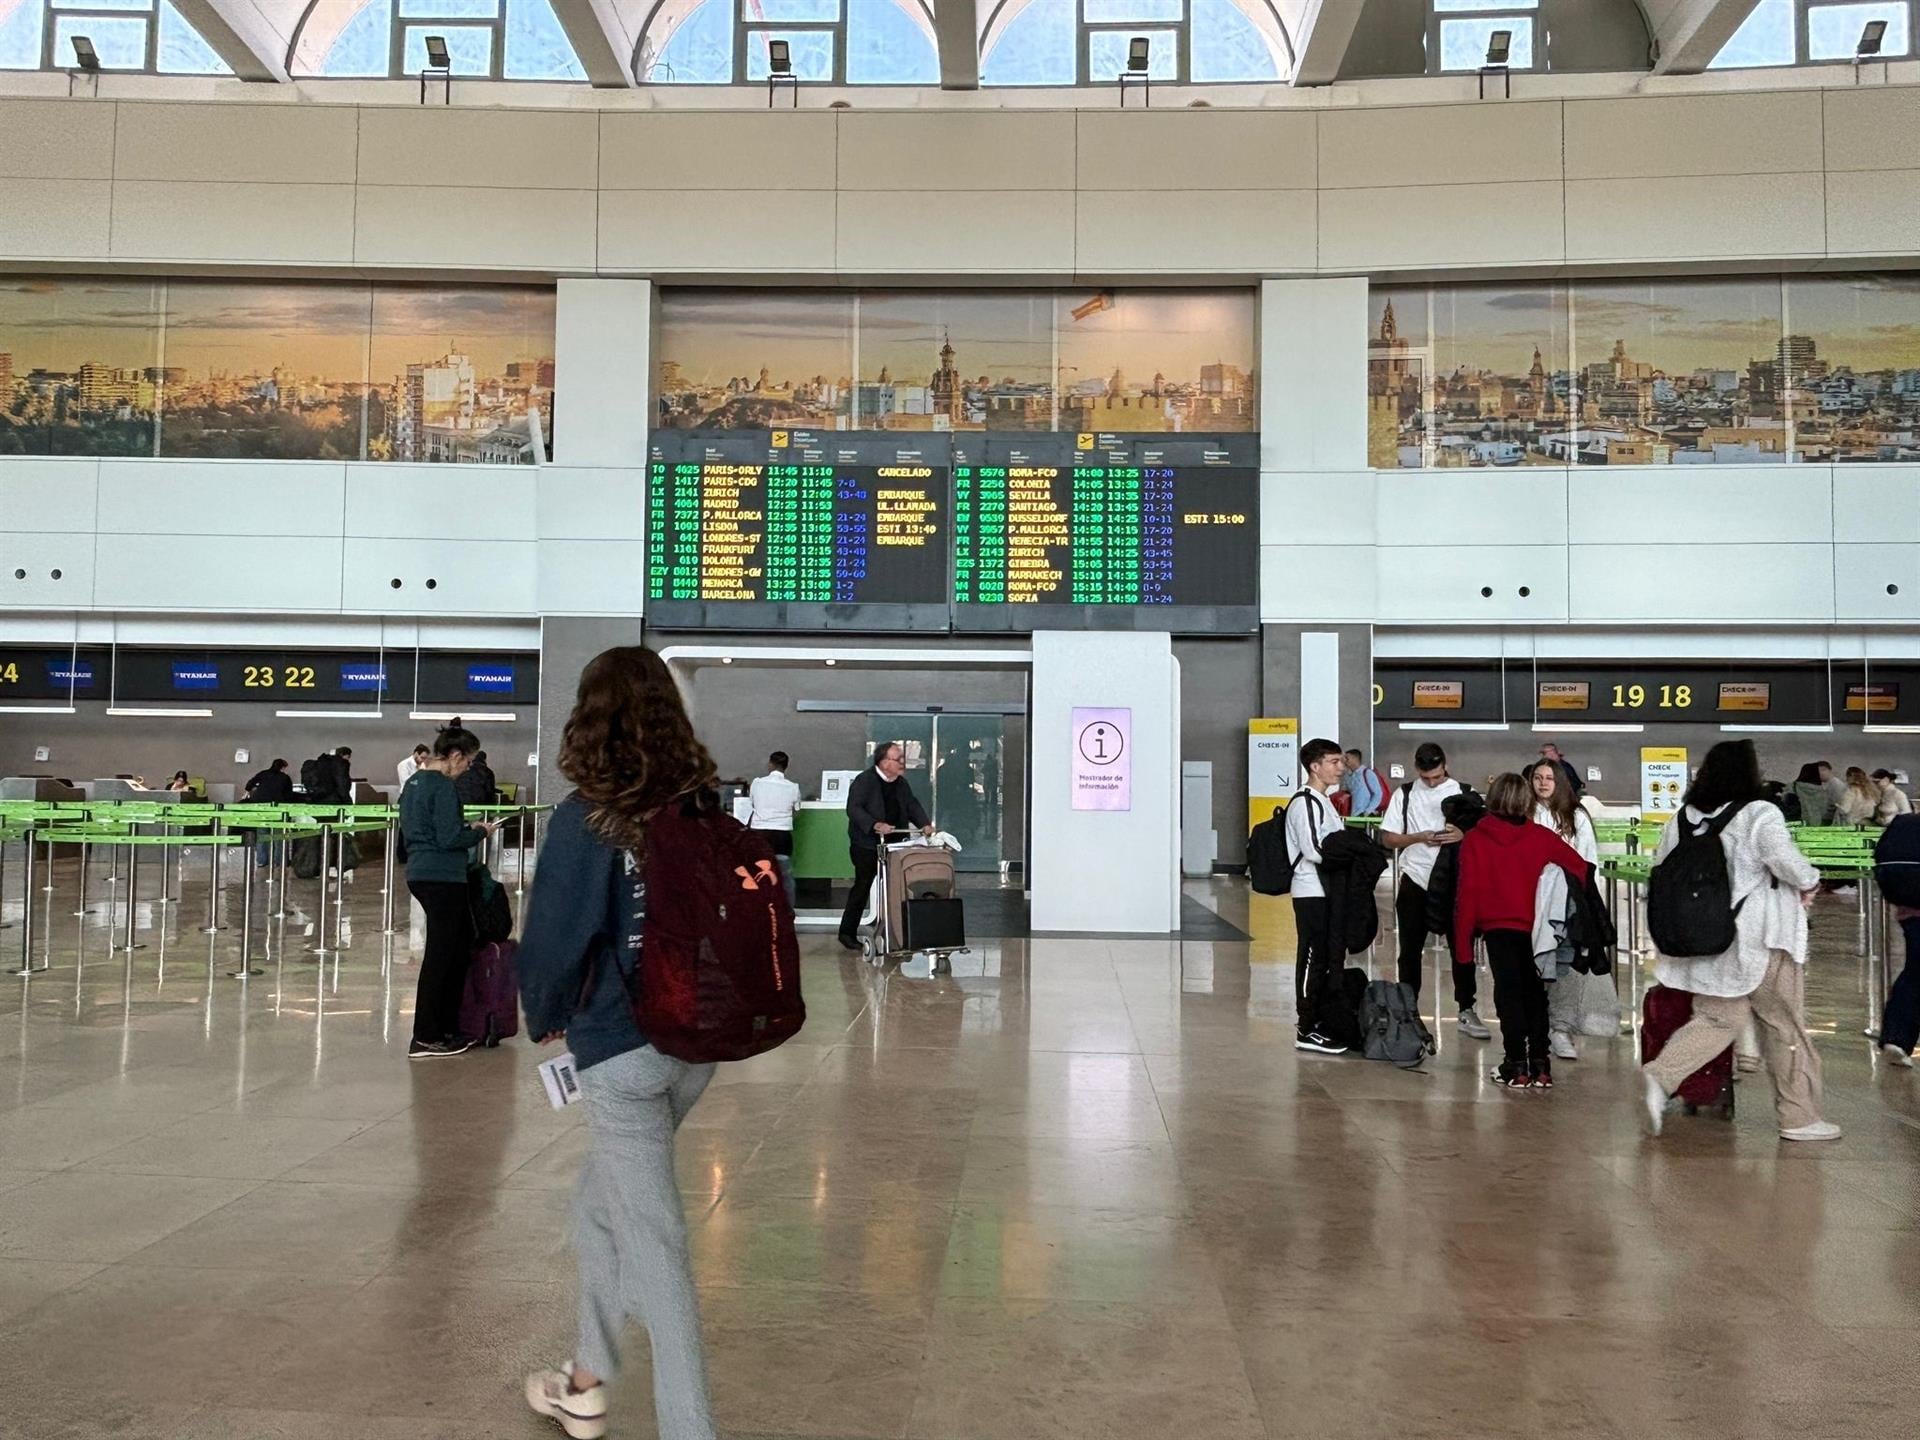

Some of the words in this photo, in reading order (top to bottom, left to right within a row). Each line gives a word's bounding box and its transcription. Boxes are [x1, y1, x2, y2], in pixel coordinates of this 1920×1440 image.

[704, 466, 762, 475] PARIS-ORLY
[768, 467, 797, 475] 11:45
[802, 467, 832, 475] 11:10
[878, 468, 931, 477] CANCELADO
[1009, 469, 1057, 477] ROMA-FCO
[1074, 469, 1103, 477] 14:00
[1108, 469, 1138, 477] 13:25
[675, 477, 699, 485] 1417
[704, 477, 756, 486] PARIS-CDG
[768, 478, 797, 486] 12:20
[802, 479, 832, 487] 11:45
[1073, 480, 1103, 489] 14:05
[1108, 481, 1138, 489] 13:30
[675, 489, 699, 497] 2141
[703, 489, 738, 497] ZURICH
[768, 490, 797, 498] 12:20
[878, 491, 925, 500] EMBARQUE
[1009, 491, 1051, 500] SEVILLA
[1073, 492, 1103, 500] 14:10
[1108, 492, 1138, 500] 13:35
[703, 500, 738, 509] MADRID
[768, 501, 797, 509] 12:25
[878, 503, 936, 511] UL.LLAMADA
[1009, 503, 1057, 511] SANTIAGO
[1073, 503, 1103, 511] 14:20
[1108, 503, 1138, 512] 13:45
[703, 511, 762, 520] P.MALLORCA
[767, 512, 797, 520] 12:35
[802, 513, 831, 521] 11:50
[877, 514, 925, 523] EMBARQUE
[1009, 514, 1068, 523] DUSSELDORF
[1073, 515, 1103, 523] 14:30
[1108, 515, 1138, 523] 14:25
[1184, 515, 1208, 524] ESTI
[1214, 515, 1244, 524] 15:00
[703, 523, 738, 531] LISBOA
[767, 524, 796, 532] 12:35
[801, 524, 831, 532] 13:05
[877, 525, 901, 534] ESTI
[907, 525, 936, 534] 13:40
[1009, 526, 1068, 534] P.MALLORCA
[1073, 526, 1103, 534] 14:50
[703, 534, 761, 542] LONDRES-ST
[767, 535, 796, 543] 12:40
[801, 535, 831, 544] 11:57
[877, 537, 924, 546] EMBARQUE
[1009, 537, 1068, 545] VENECIA-TR
[1073, 537, 1103, 546] 14:55
[1107, 538, 1138, 546] 14:20
[703, 545, 756, 554] FRANKFURT
[767, 546, 796, 554] 12:50
[801, 547, 831, 555] 12:15
[1009, 548, 1044, 557] ZURICH
[1073, 549, 1103, 557] 15:00
[1107, 549, 1138, 557] 14:25
[767, 558, 796, 566] 13:05
[801, 558, 831, 566] 12:35
[1073, 560, 1102, 568] 15:05
[1107, 560, 1138, 569] 14:35
[767, 569, 796, 577] 13:10
[801, 570, 830, 578] 12:35
[1008, 571, 1062, 580] MARRAKECH
[1072, 572, 1102, 580] 15:10
[1107, 572, 1138, 580] 14:35
[766, 580, 796, 588] 13:25
[1008, 582, 1056, 591] ROMA-FCO
[1072, 583, 1102, 591] 15:15
[1107, 583, 1137, 591] 14:40
[702, 591, 755, 599] BARCELONA
[766, 592, 796, 600] 13:45
[800, 592, 830, 600] 13:20
[1008, 594, 1038, 602] SOFIA
[1072, 594, 1102, 603] 15:25
[1107, 595, 1137, 603] 14:50
[0, 662, 19, 683] 4
[244, 666, 274, 687] 23
[285, 666, 315, 688] 22
[1612, 685, 1645, 707] 19
[1659, 685, 1692, 708] 18
